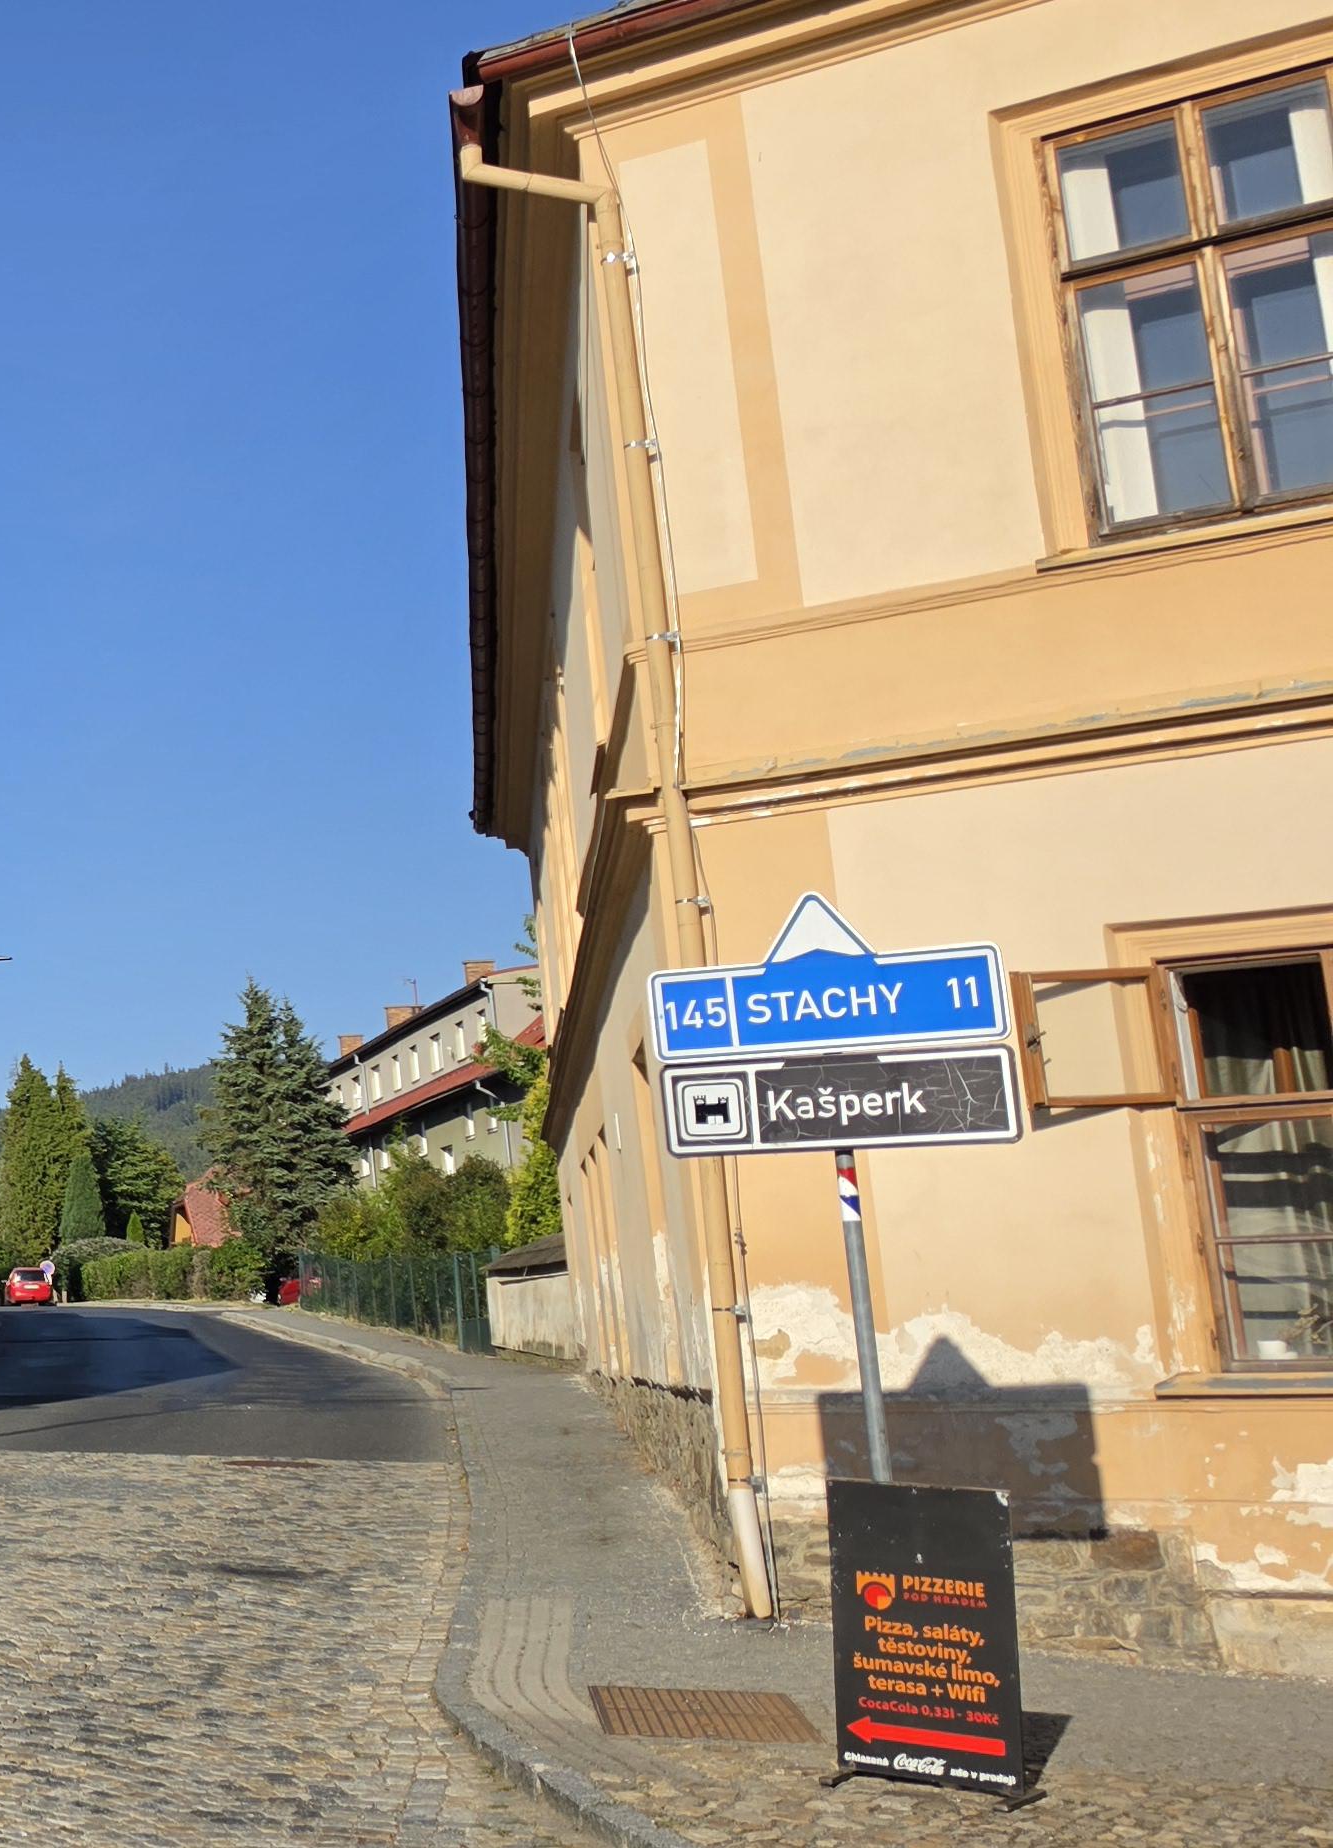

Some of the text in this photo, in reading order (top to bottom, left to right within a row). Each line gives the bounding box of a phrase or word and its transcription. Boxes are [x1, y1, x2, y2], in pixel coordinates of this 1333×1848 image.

[665, 976, 980, 1031] 145 STACHY 11
[767, 1082, 927, 1126] Kašperk
[902, 1575, 986, 1598] PIZZERIE
[903, 1592, 988, 1609] POD HRADEM
[864, 1615, 985, 1648] Pizza, saláty,
[877, 1637, 972, 1664] těstoviny,
[853, 1651, 1001, 1687] šumavské limo,
[868, 1674, 986, 1703] terasa + Wifi
[858, 1697, 918, 1715] CocaCola
